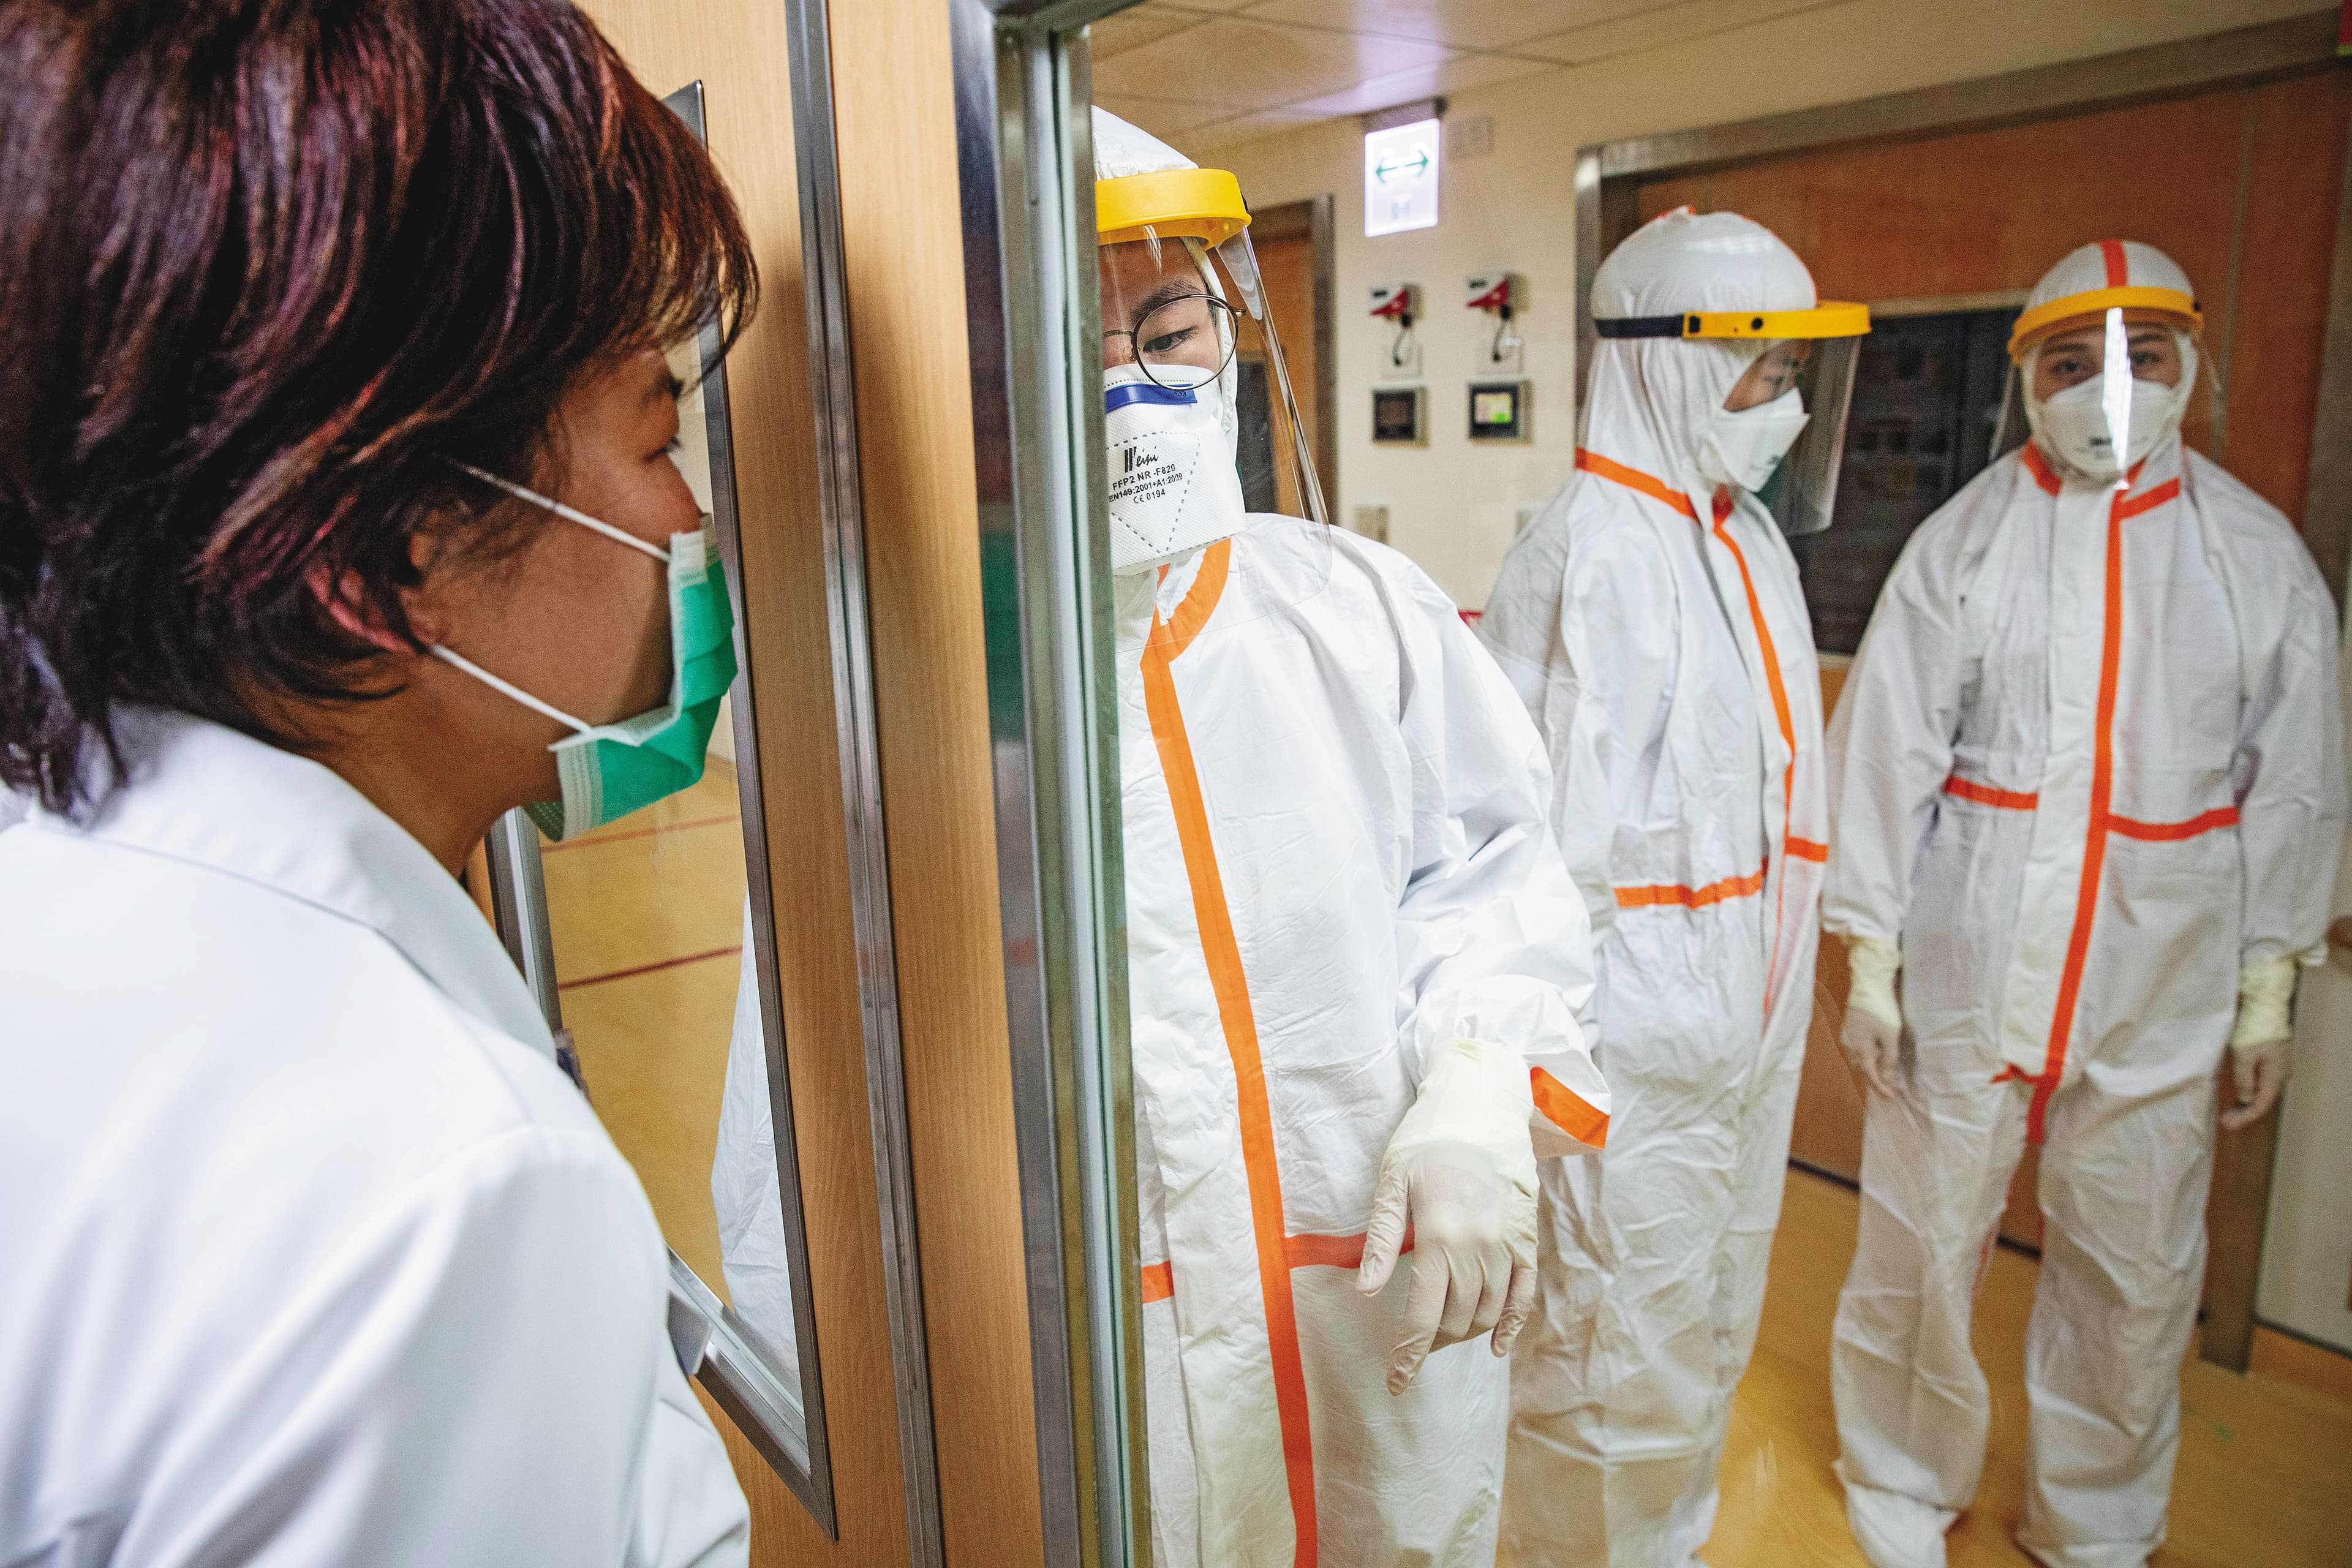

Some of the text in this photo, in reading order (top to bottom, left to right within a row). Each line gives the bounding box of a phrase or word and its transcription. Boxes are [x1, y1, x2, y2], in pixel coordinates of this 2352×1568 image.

[1109, 472, 1183, 502] EN149:2001+A1:2009
[1112, 475, 1136, 491] FFP2
[1137, 470, 1152, 481] NR
[1146, 488, 1166, 500] 0194
